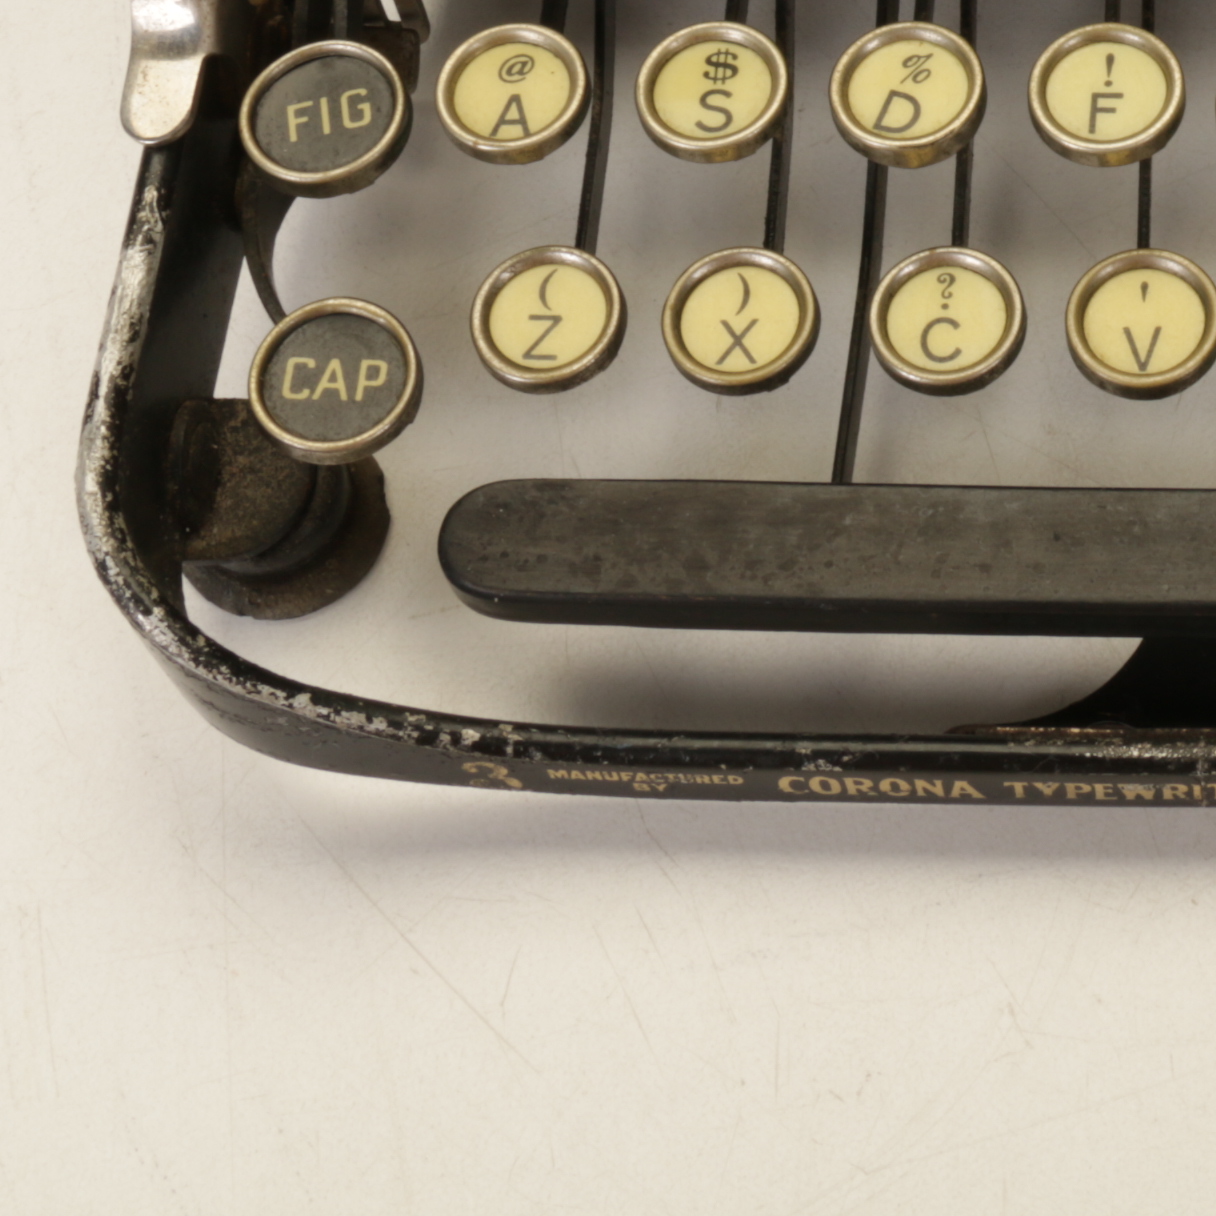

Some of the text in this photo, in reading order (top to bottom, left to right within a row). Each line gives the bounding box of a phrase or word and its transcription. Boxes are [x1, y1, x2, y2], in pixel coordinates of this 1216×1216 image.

[498, 54, 535, 83] @
[703, 49, 738, 84] $
[900, 53, 933, 84] %
[1104, 53, 1115, 87] !
[287, 88, 371, 142] FIG
[488, 92, 533, 139] A
[695, 89, 733, 133] S
[871, 90, 922, 134] D
[1088, 92, 1124, 134] F
[937, 272, 956, 310] ?
[522, 314, 562, 361] Z
[715, 319, 758, 365] X
[920, 317, 962, 363] C
[1123, 325, 1161, 372] V
[282, 357, 388, 401] CAP
[547, 769, 744, 785] MANUFACTURED
[633, 783, 668, 792] BY
[778, 776, 986, 799] CORONA
